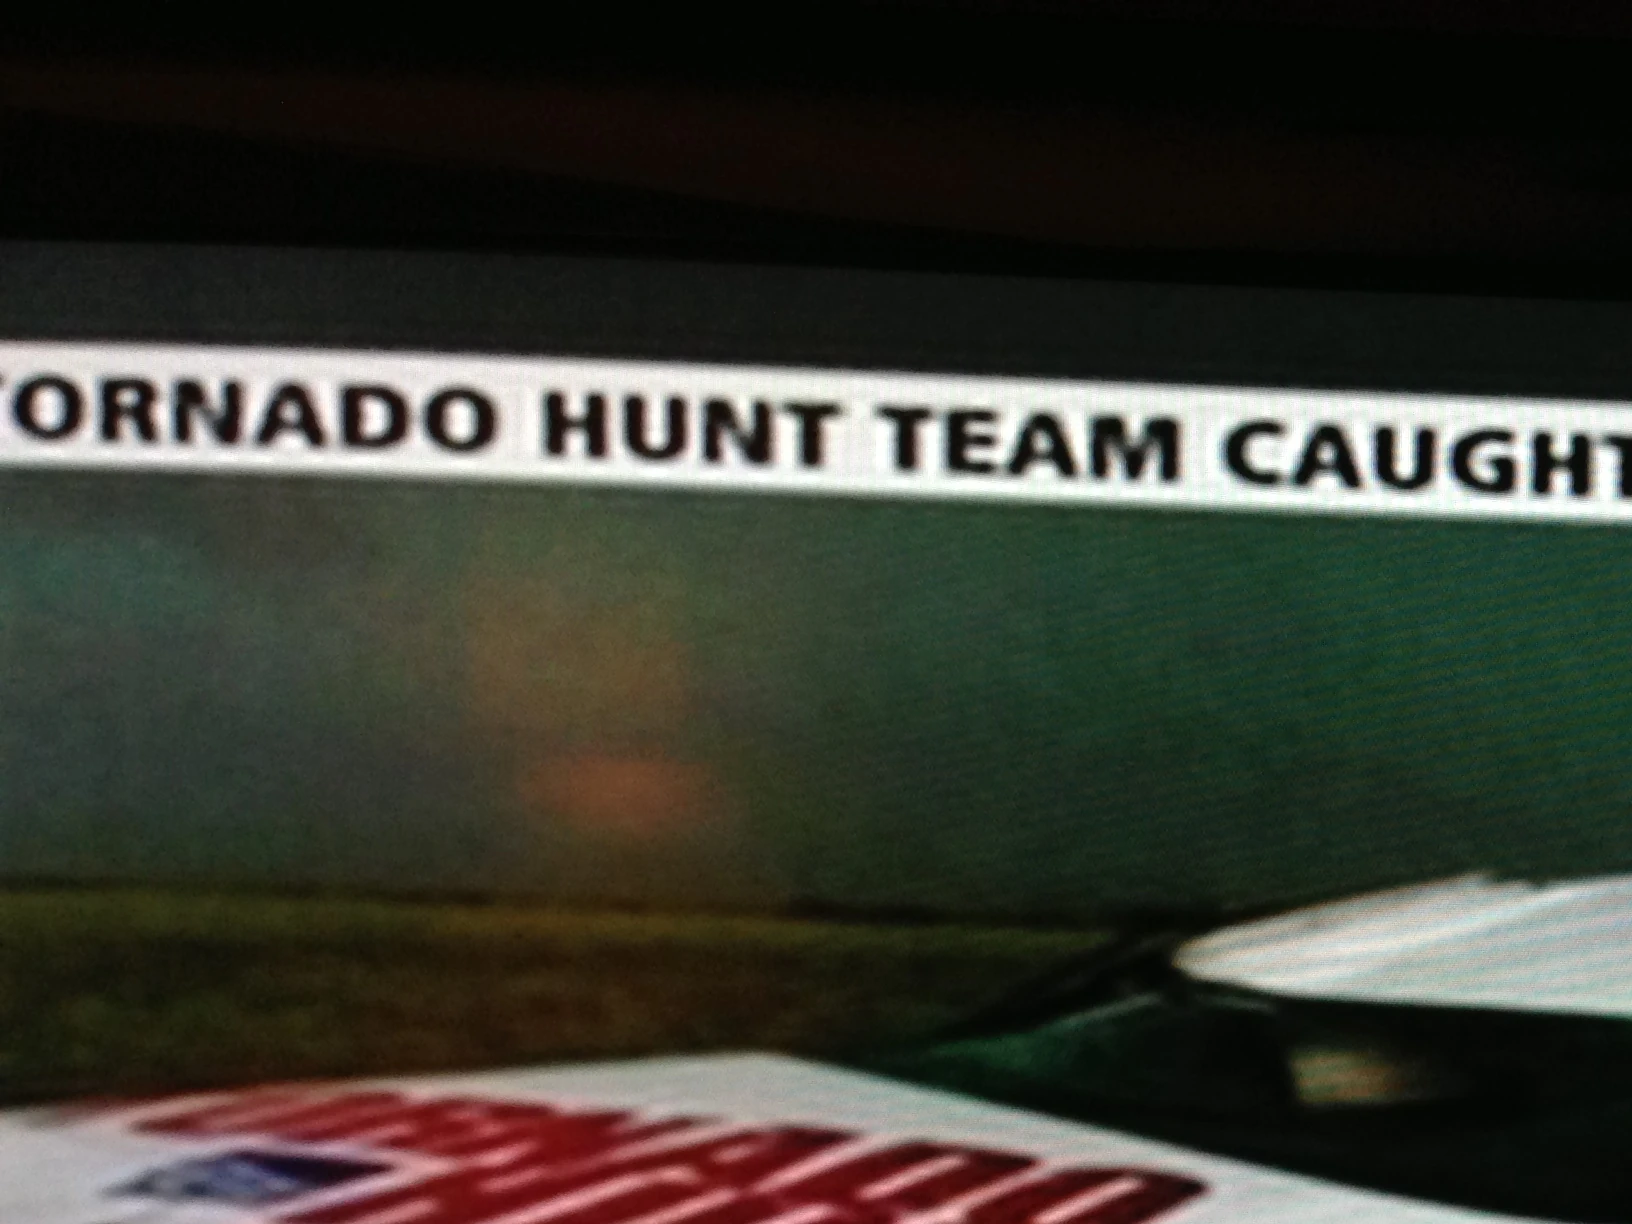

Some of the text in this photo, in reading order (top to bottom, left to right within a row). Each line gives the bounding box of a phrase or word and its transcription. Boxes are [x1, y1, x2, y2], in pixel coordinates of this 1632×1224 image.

[0, 372, 497, 455] ORNADO
[540, 390, 840, 468] HUNT
[877, 405, 1184, 484] TEAM
